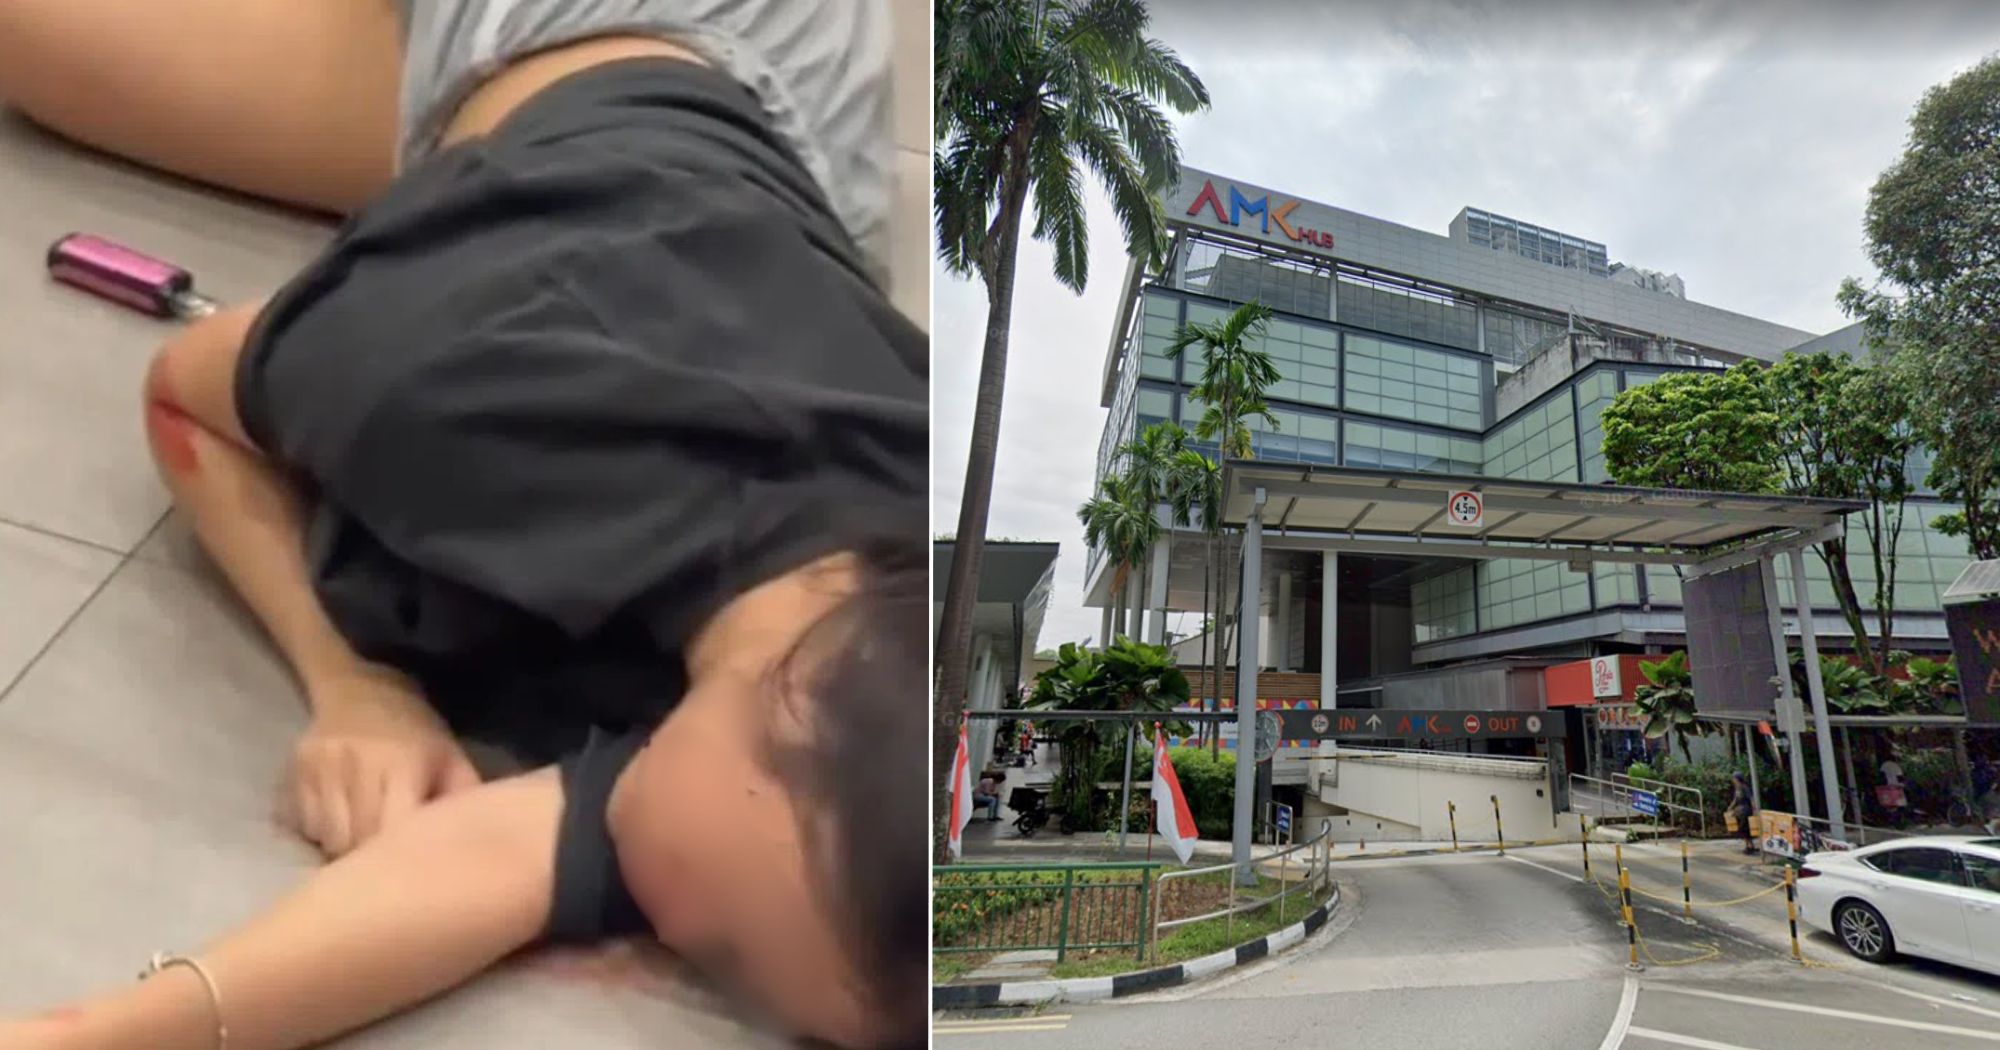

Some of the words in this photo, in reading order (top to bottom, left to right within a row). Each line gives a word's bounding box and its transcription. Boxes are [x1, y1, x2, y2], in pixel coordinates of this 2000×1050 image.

[1186, 178, 1302, 242] AMK
[1297, 226, 1335, 250] HUB
[1454, 501, 1476, 515] 4.5m
[1338, 715, 1357, 731] IN
[1487, 716, 1520, 733] OUT
